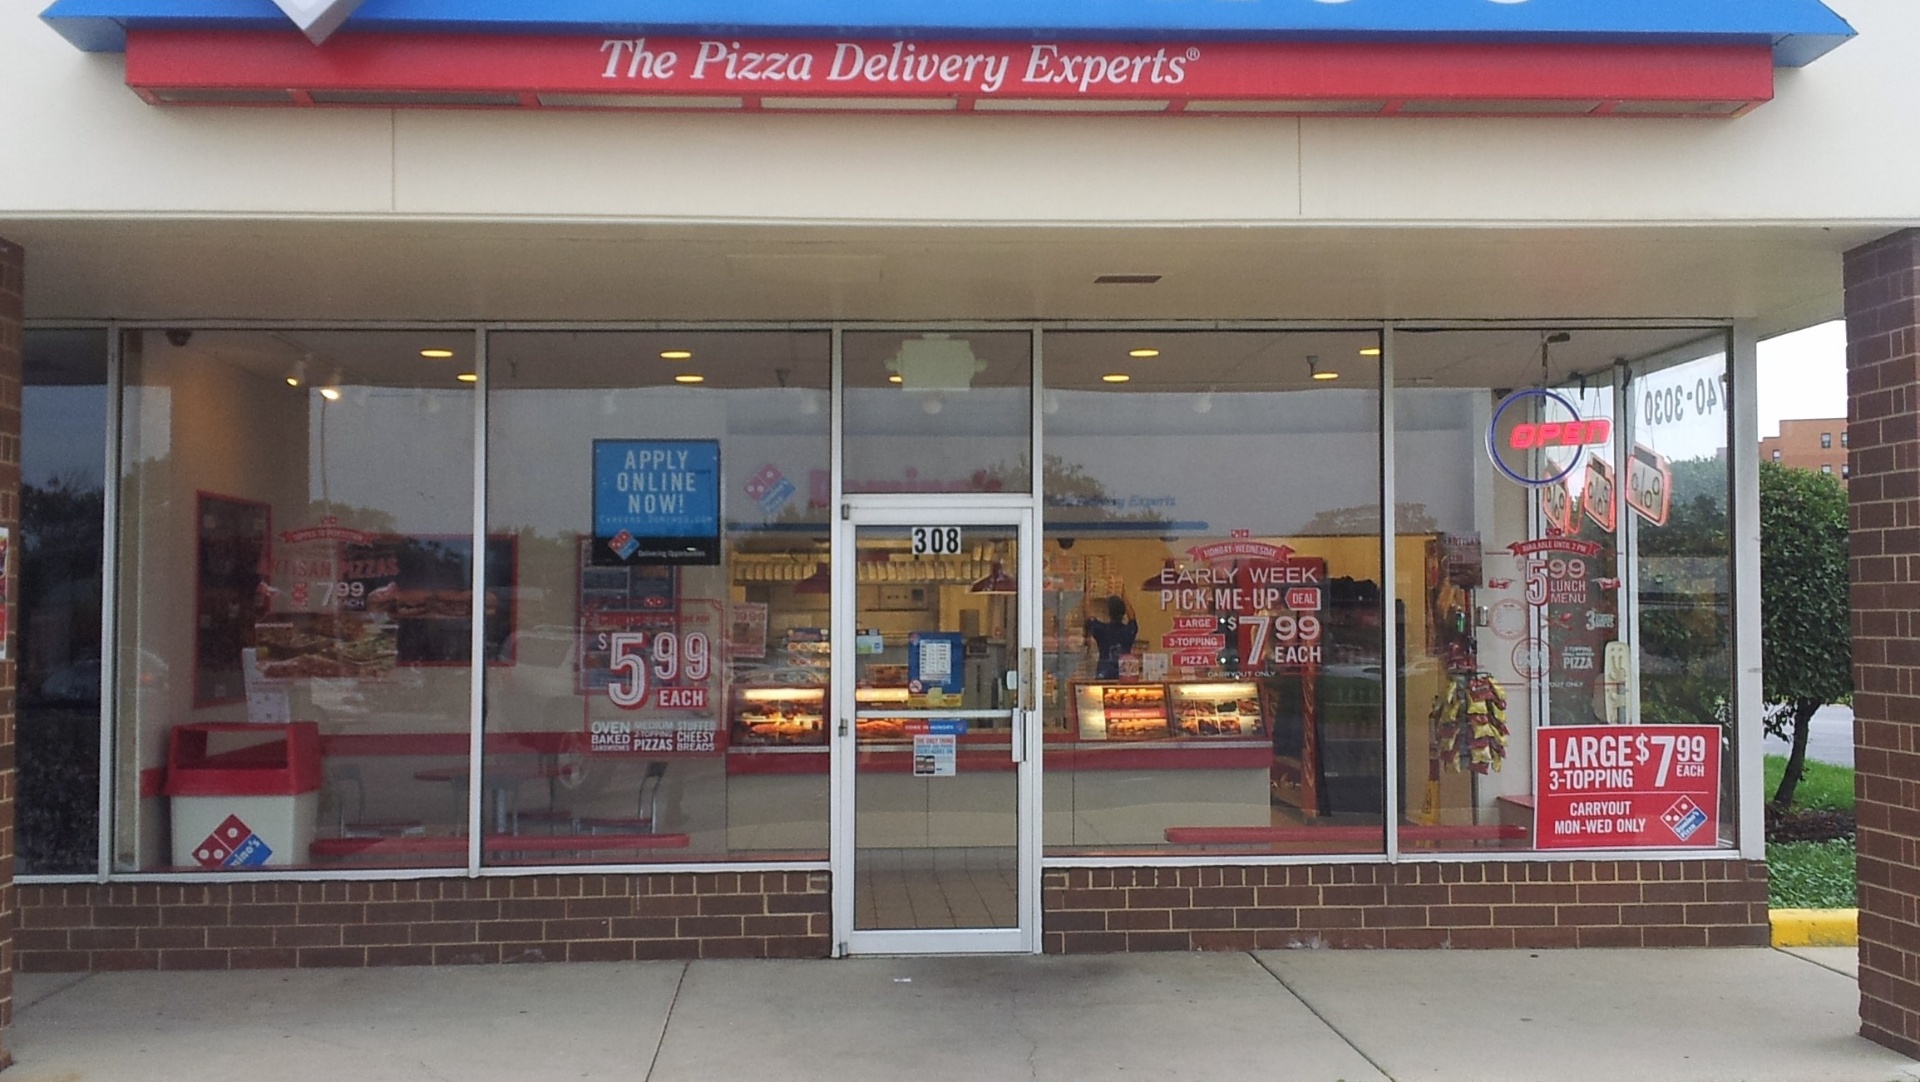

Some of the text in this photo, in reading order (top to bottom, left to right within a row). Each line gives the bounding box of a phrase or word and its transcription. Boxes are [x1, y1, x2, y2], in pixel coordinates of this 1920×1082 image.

[599, 40, 677, 80] The
[690, 42, 813, 82] Pizza
[826, 41, 1011, 92] Delivery
[1509, 419, 1611, 450] OPEN
[624, 449, 689, 471] APPLY
[616, 472, 697, 492] ONLINE
[628, 493, 685, 514] NOW!
[913, 528, 960, 554] 308
[1160, 567, 1319, 584] EARLY WEEK
[1550, 580, 1586, 592] LUNCH
[1160, 588, 1316, 610] PICK-ME-UP DEAL
[1550, 593, 1586, 603] MENU
[1178, 618, 1212, 628] LARGE
[1168, 636, 1219, 647] 3-TOPPING
[1180, 655, 1210, 665] PIZZA
[1274, 646, 1322, 662] EACH
[1562, 657, 1594, 669] PIZZA
[659, 689, 704, 707] EACH
[591, 721, 631, 734] OVEN
[591, 734, 631, 744] BAKED
[633, 738, 674, 751] PIZZAS
[676, 731, 716, 743] CHEESY
[676, 743, 716, 751] BREADS
[1549, 735, 1634, 769] LARGE
[1549, 768, 1634, 790] 3-TOPPING
[1676, 765, 1705, 777] EACH
[1569, 801, 1632, 817] CARRYOUT
[1554, 818, 1646, 835] MON-WED ONLY
